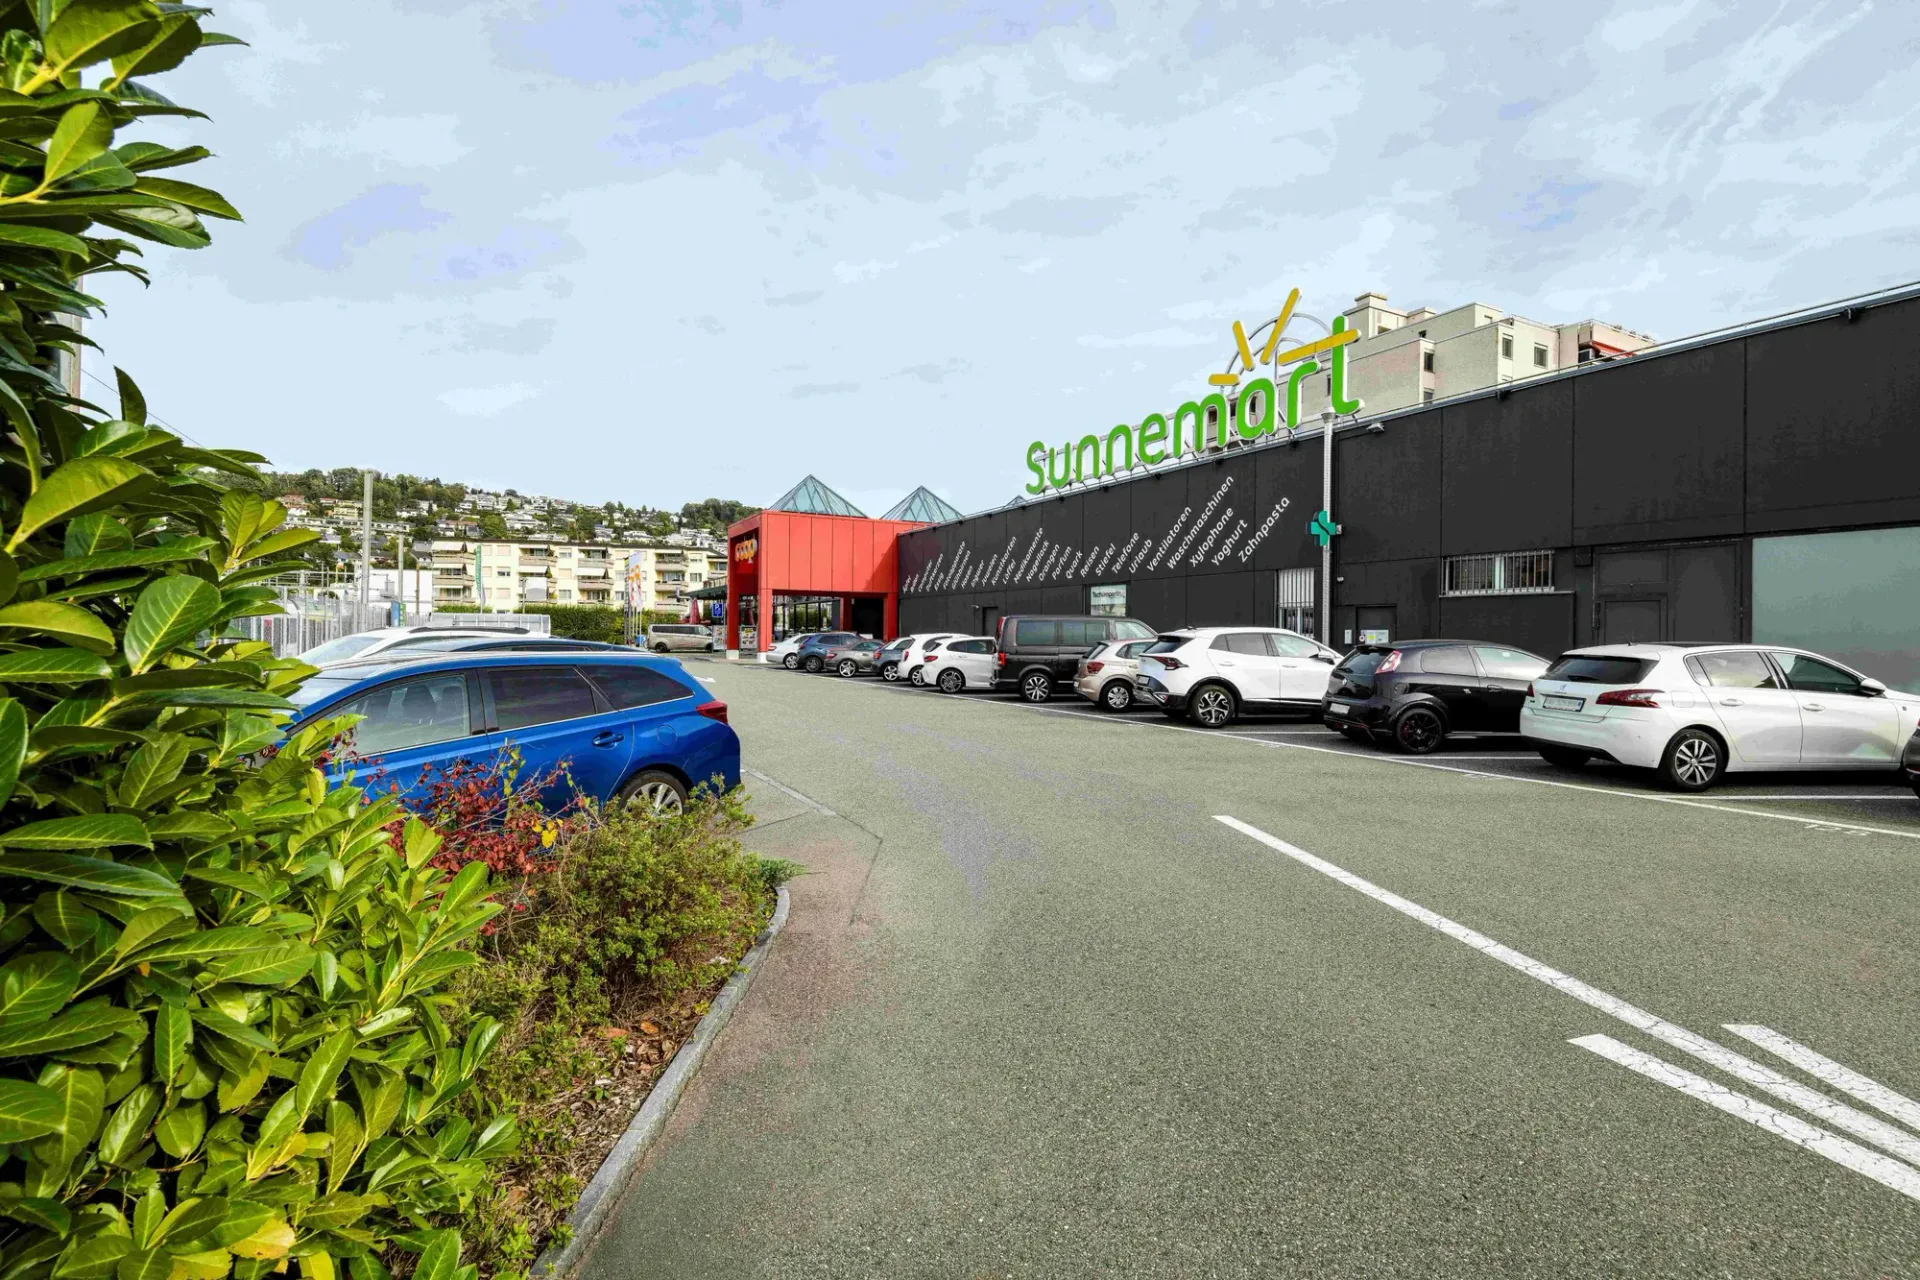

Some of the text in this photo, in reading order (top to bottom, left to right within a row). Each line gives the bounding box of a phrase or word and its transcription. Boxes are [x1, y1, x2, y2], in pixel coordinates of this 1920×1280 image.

[1147, 506, 1192, 572] Ventilatoren
[1167, 475, 1235, 570] Waschmaschinen
[1189, 507, 1234, 568] Xylophone
[1211, 519, 1249, 567] Yoghurt
[1238, 496, 1290, 563] Zahnpasta
[981, 554, 998, 587] Juwelen
[991, 536, 1017, 586] Kunstkarten
[1013, 527, 1043, 584] Medikamente
[1026, 540, 1050, 582] Nagellack
[1038, 544, 1060, 581] Orangen
[1065, 550, 1083, 579] Quark
[1080, 546, 1100, 578] Reisen
[1095, 543, 1116, 576] Stiefel
[1112, 532, 1139, 574] Telefone
[1129, 539, 1152, 574] Urlaub
